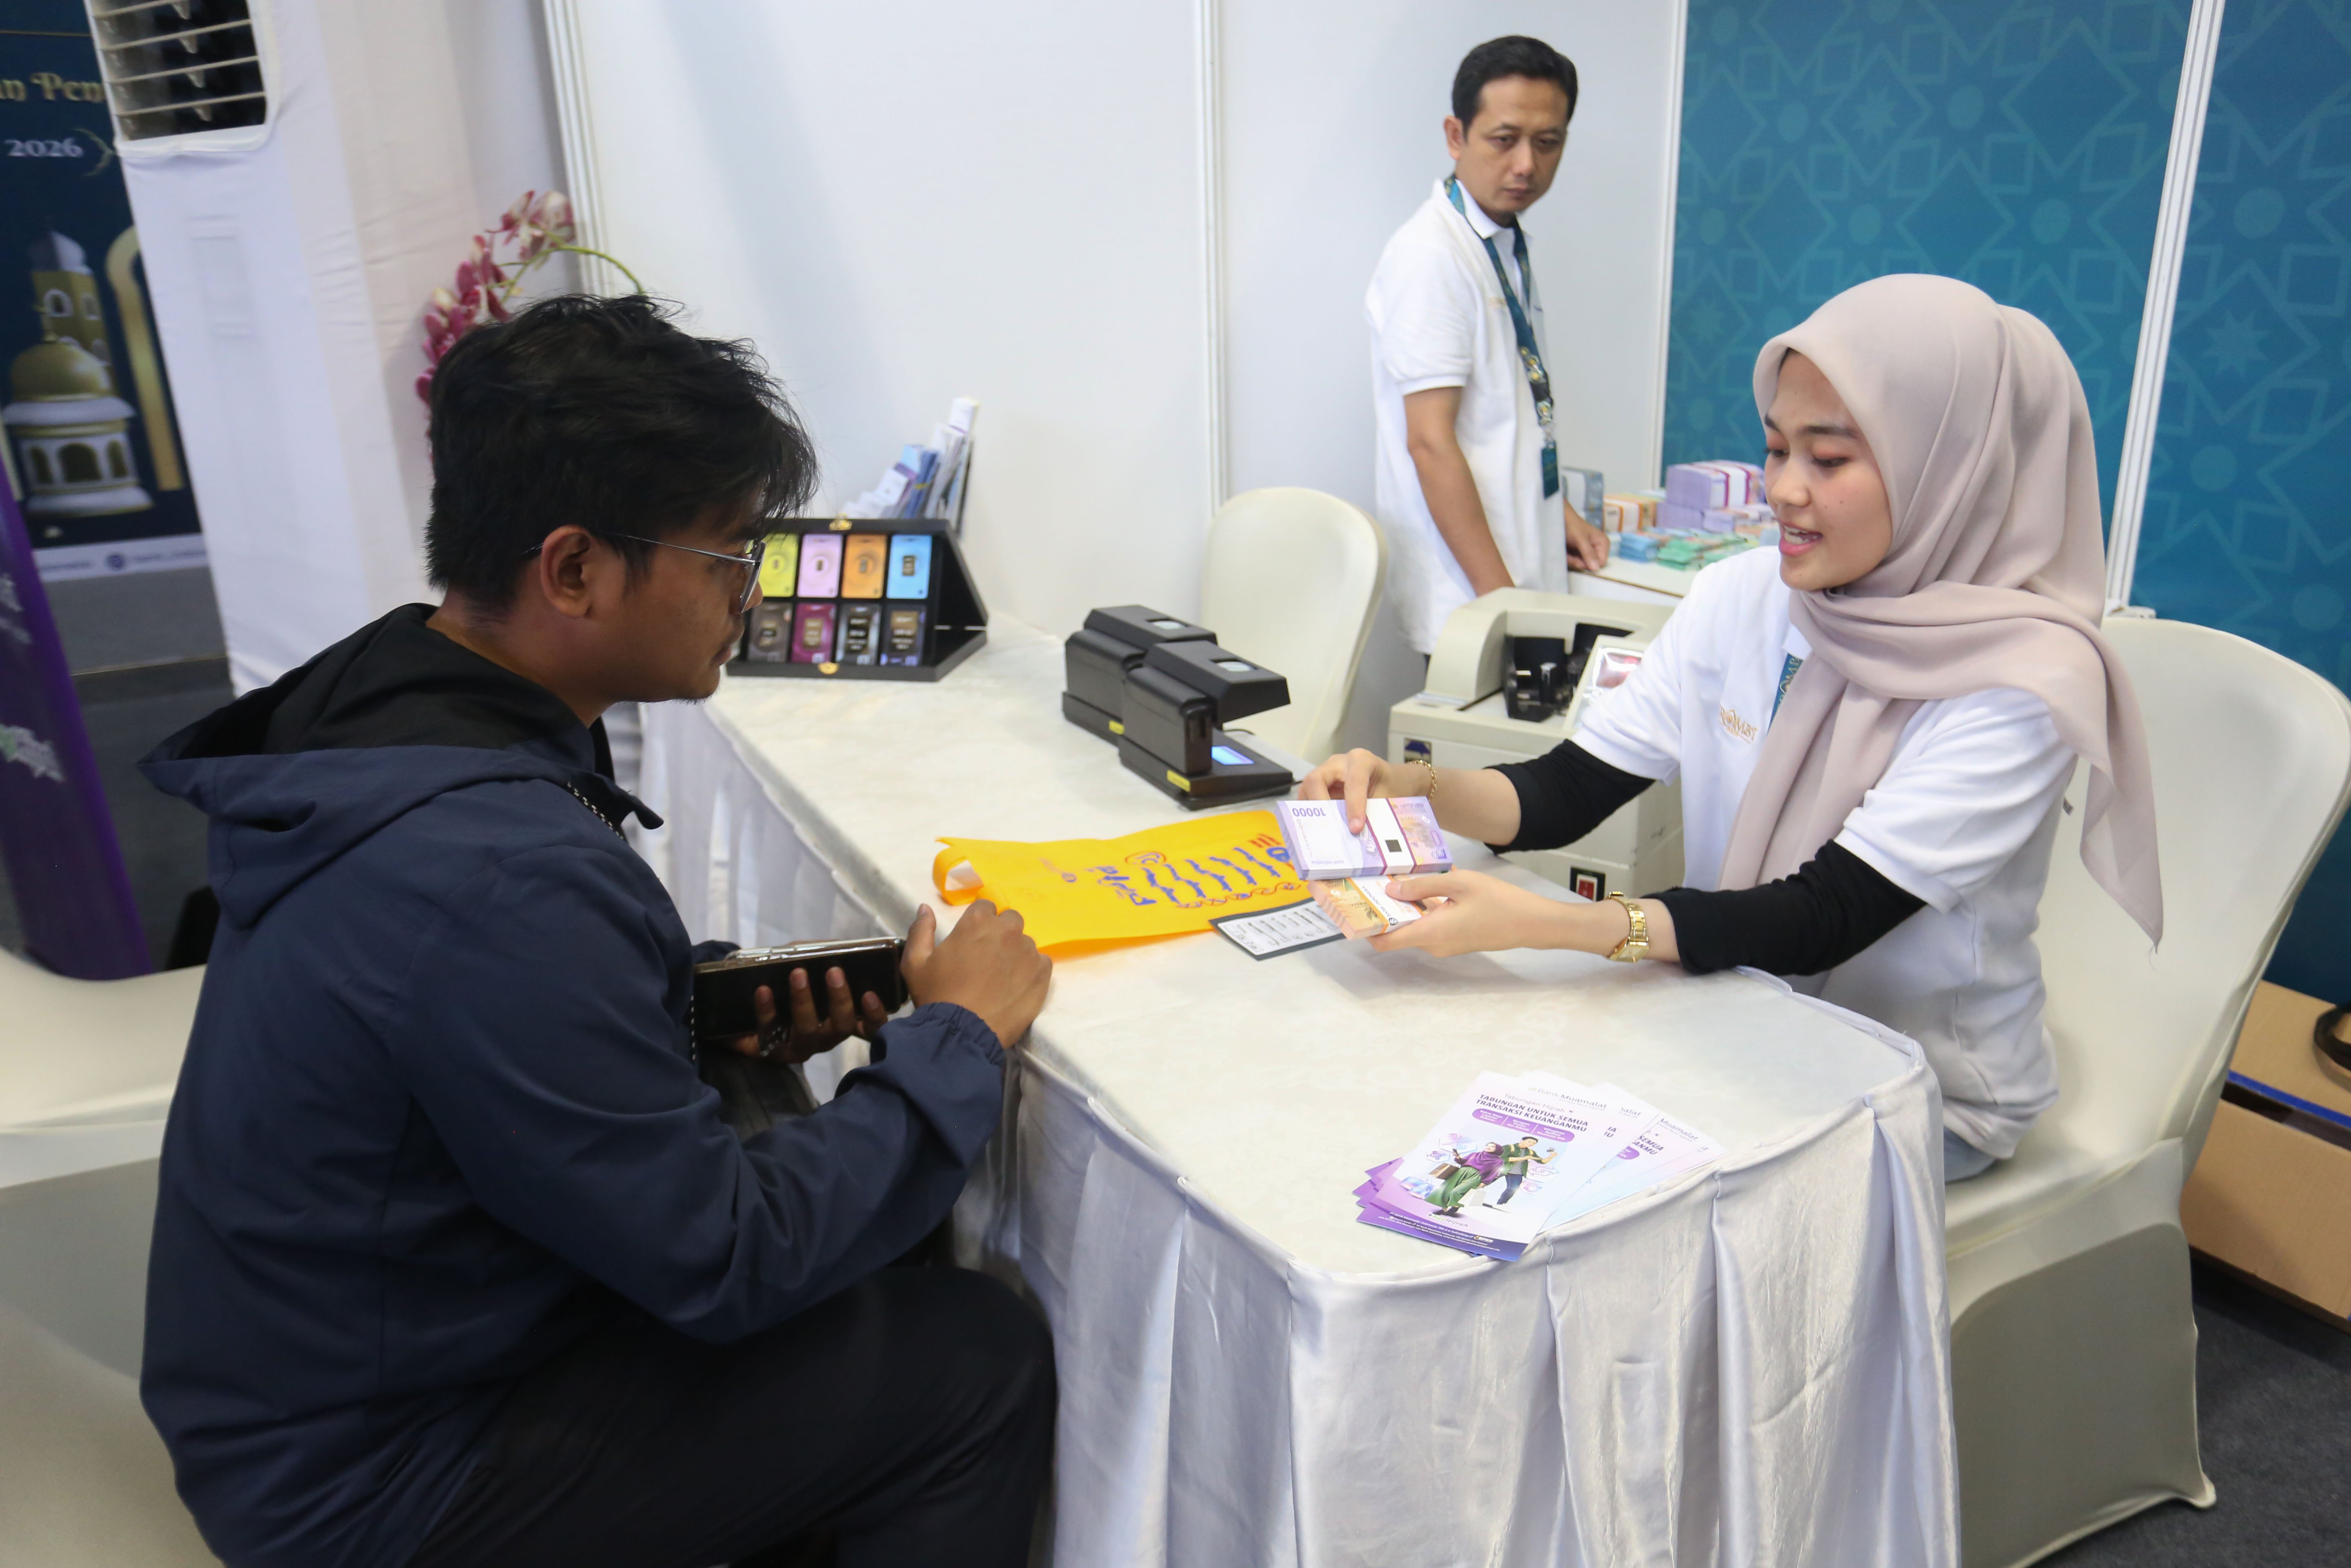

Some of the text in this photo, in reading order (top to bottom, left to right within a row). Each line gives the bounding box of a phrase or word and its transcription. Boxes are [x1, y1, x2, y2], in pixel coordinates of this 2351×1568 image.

[4, 138, 85, 157] 2026
[1292, 808, 1326, 817] 10000
[1504, 1094, 1565, 1114] Tabungan Hijrah
[1538, 1088, 1607, 1109] Bank Muamalat
[1475, 1099, 1587, 1132] TRANSAKSI KEUANGANMU
[1480, 1094, 1588, 1126] TABUNGAN UNTUK SEMUA
[1638, 1136, 1664, 1151] SEMUA
[1427, 1214, 1469, 1228] #AyoHijrah
